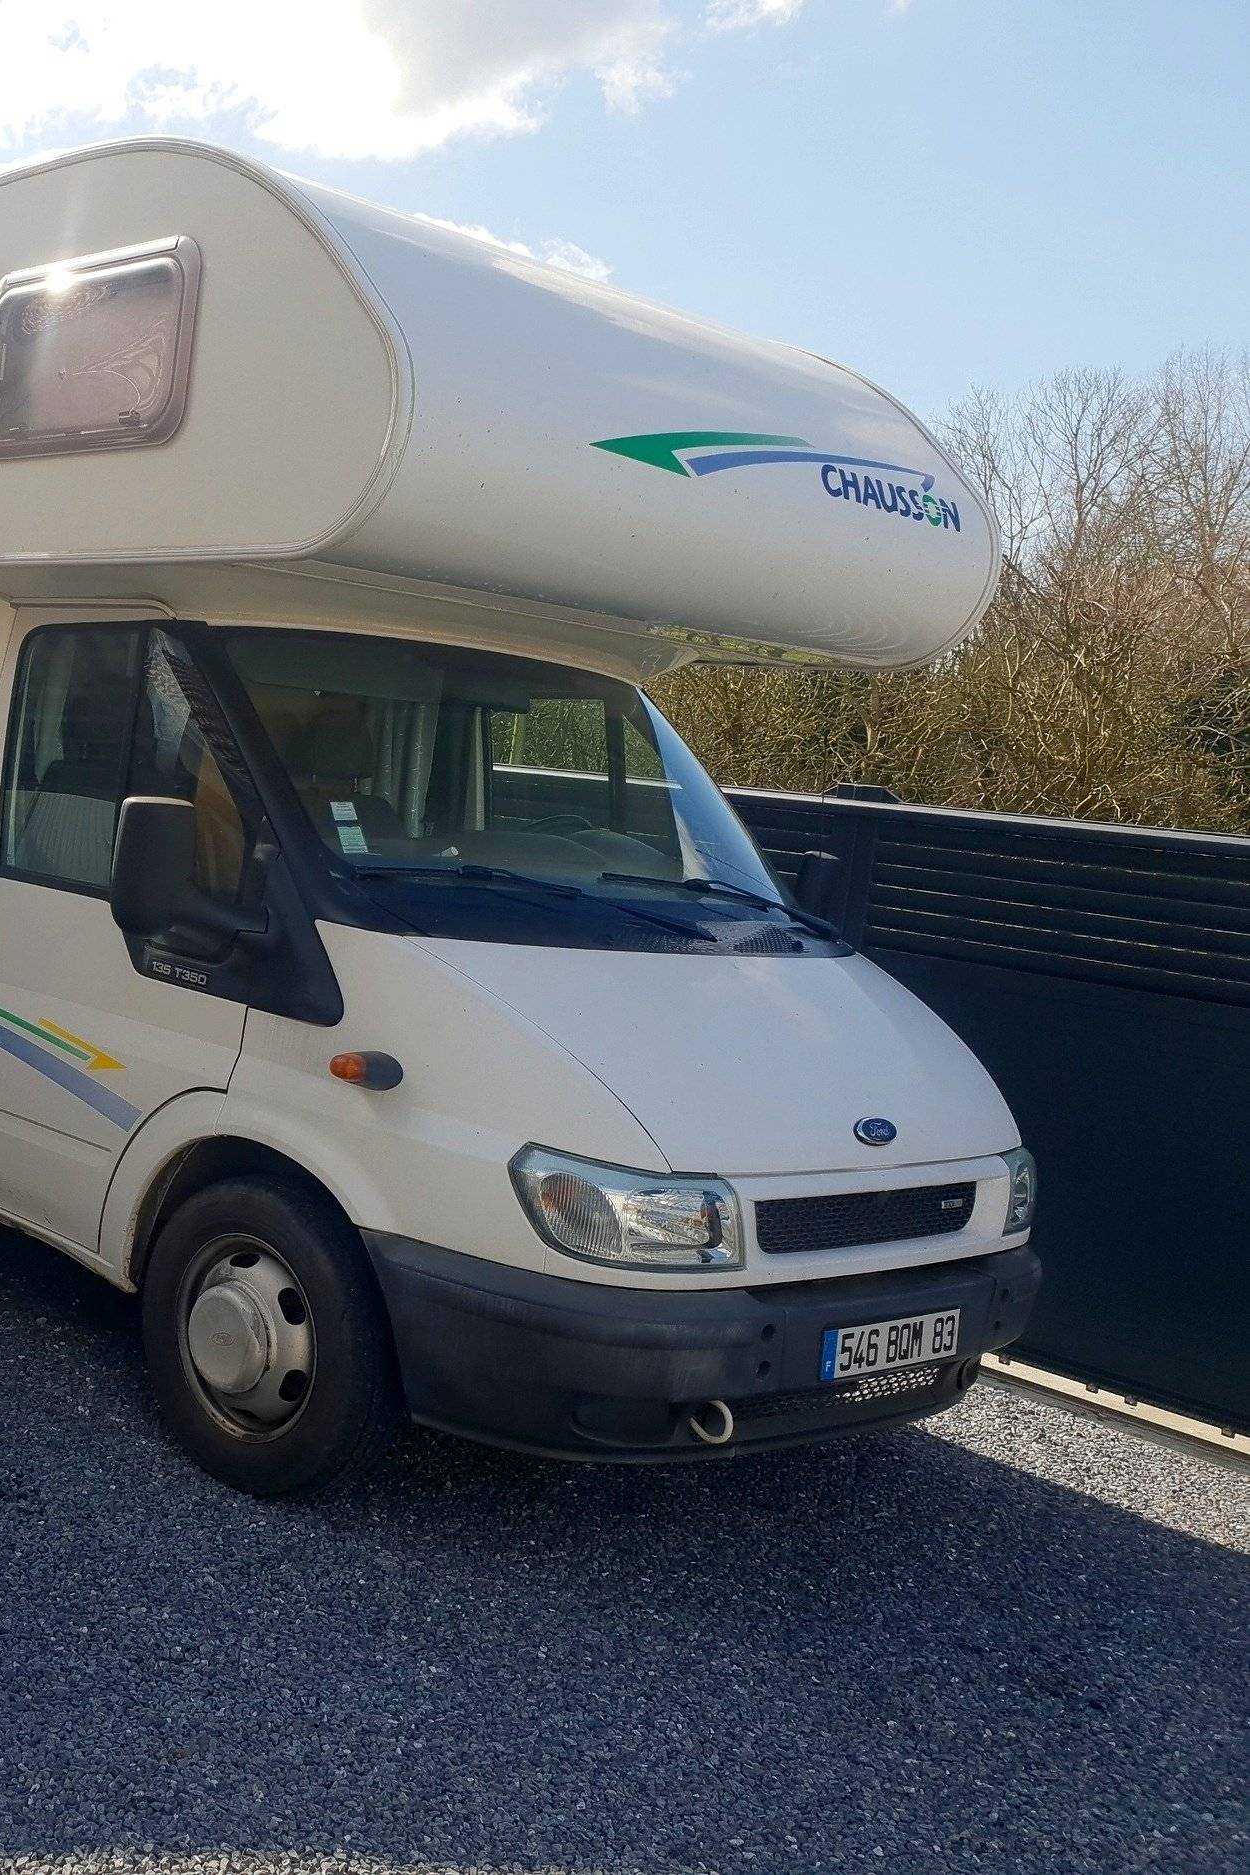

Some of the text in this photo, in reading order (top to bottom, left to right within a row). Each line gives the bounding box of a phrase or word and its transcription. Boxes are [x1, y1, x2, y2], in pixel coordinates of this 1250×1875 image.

[820, 464, 961, 532] CHAUSSON
[152, 961, 207, 985] 135 T350
[870, 1122, 890, 1136] Ford
[839, 1315, 956, 1371] 546 BQM 83
[825, 1361, 832, 1372] F
